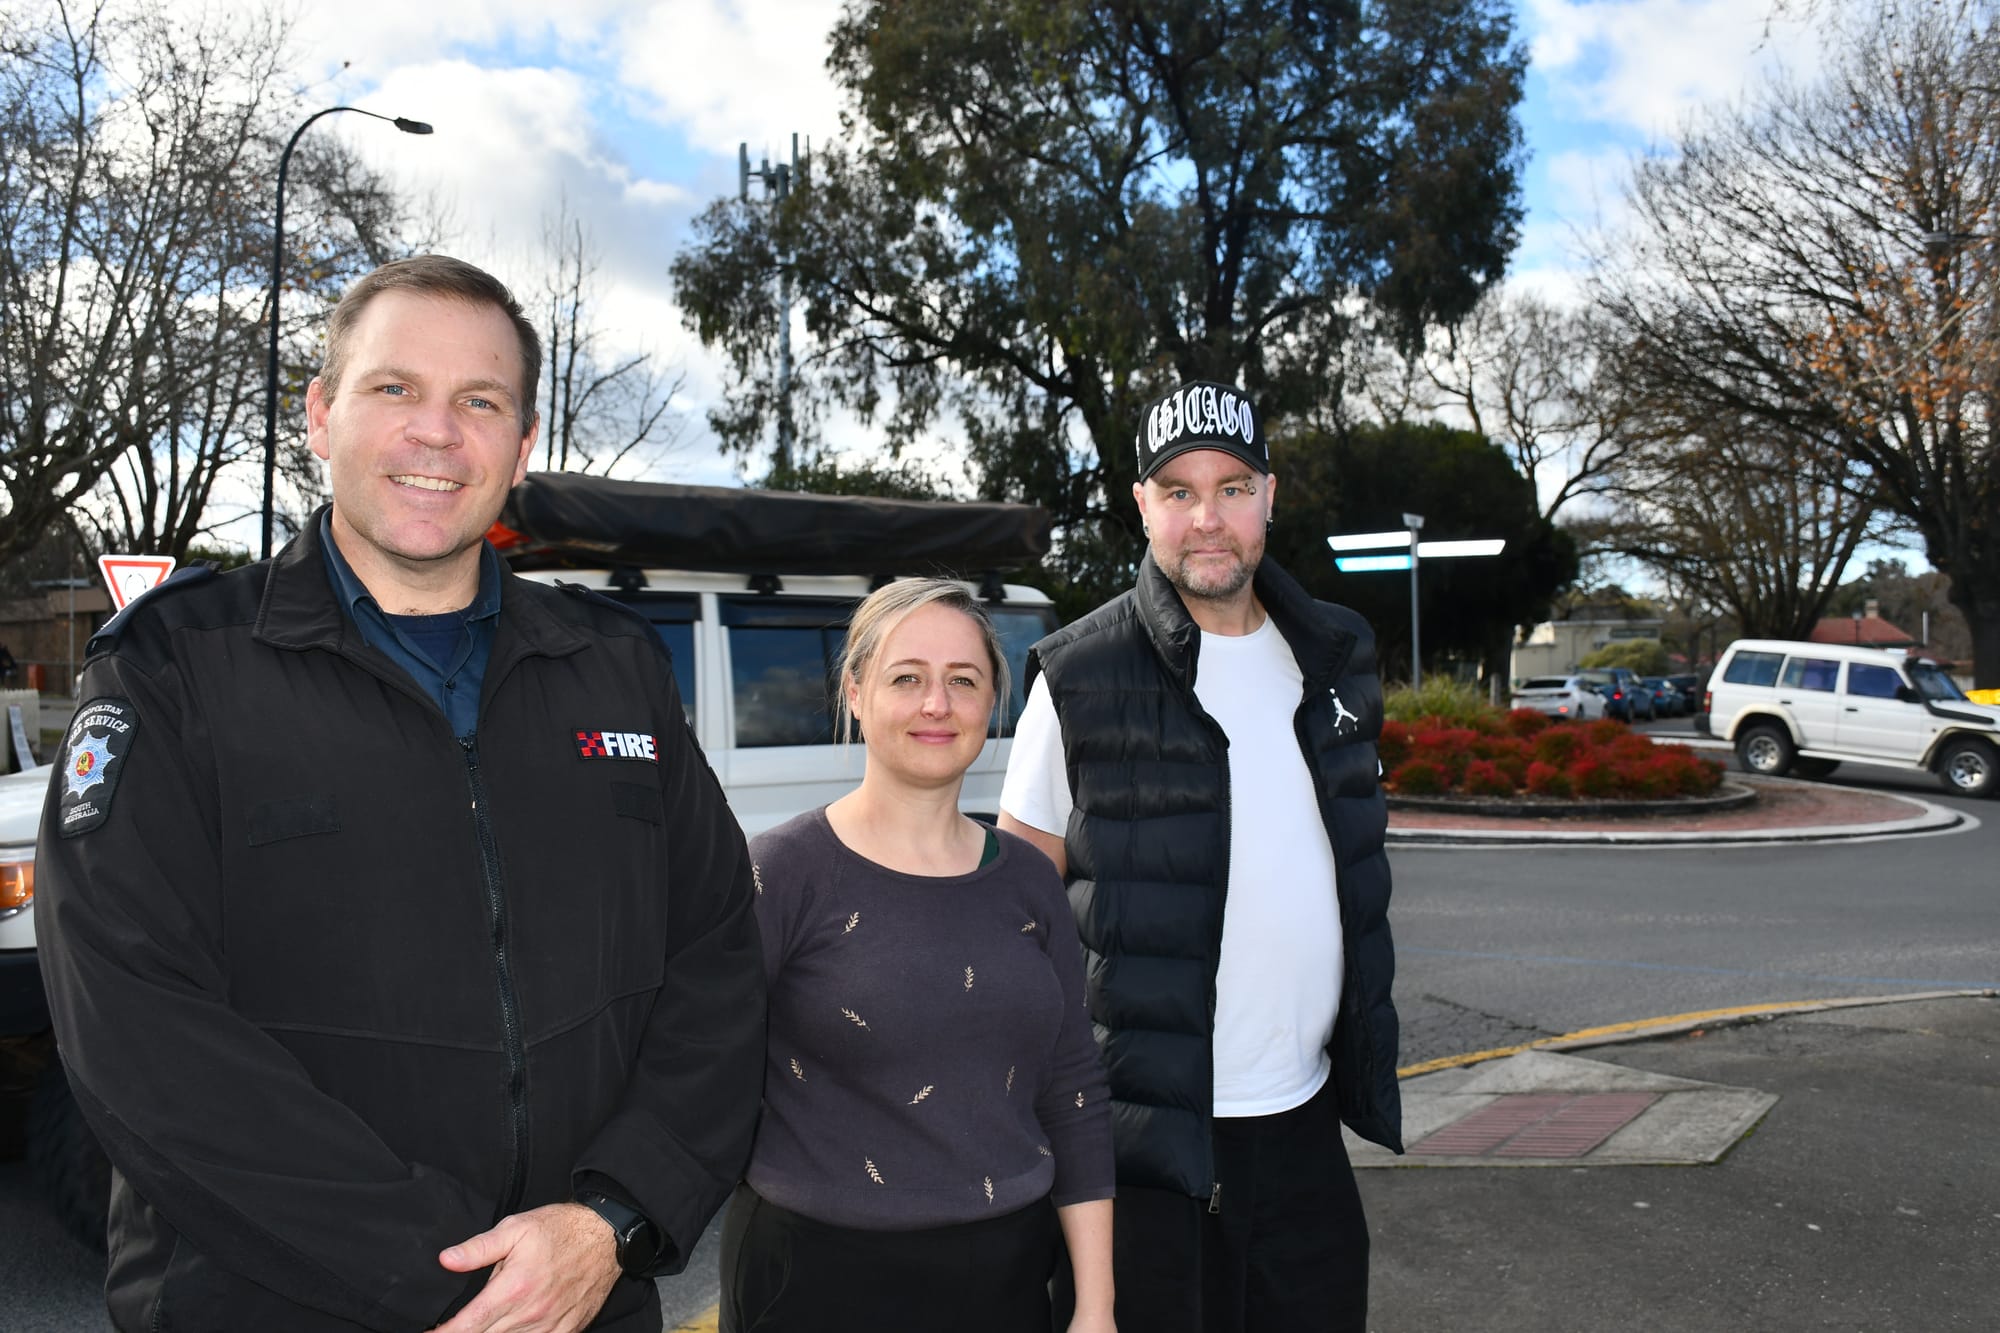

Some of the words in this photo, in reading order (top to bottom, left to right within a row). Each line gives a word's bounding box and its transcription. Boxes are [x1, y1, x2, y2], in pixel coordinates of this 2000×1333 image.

[1147, 385, 1254, 454] CHICAGO
[83, 714, 130, 733] SERVICE
[600, 731, 656, 760] FIRE
[69, 801, 91, 815] SOUTH
